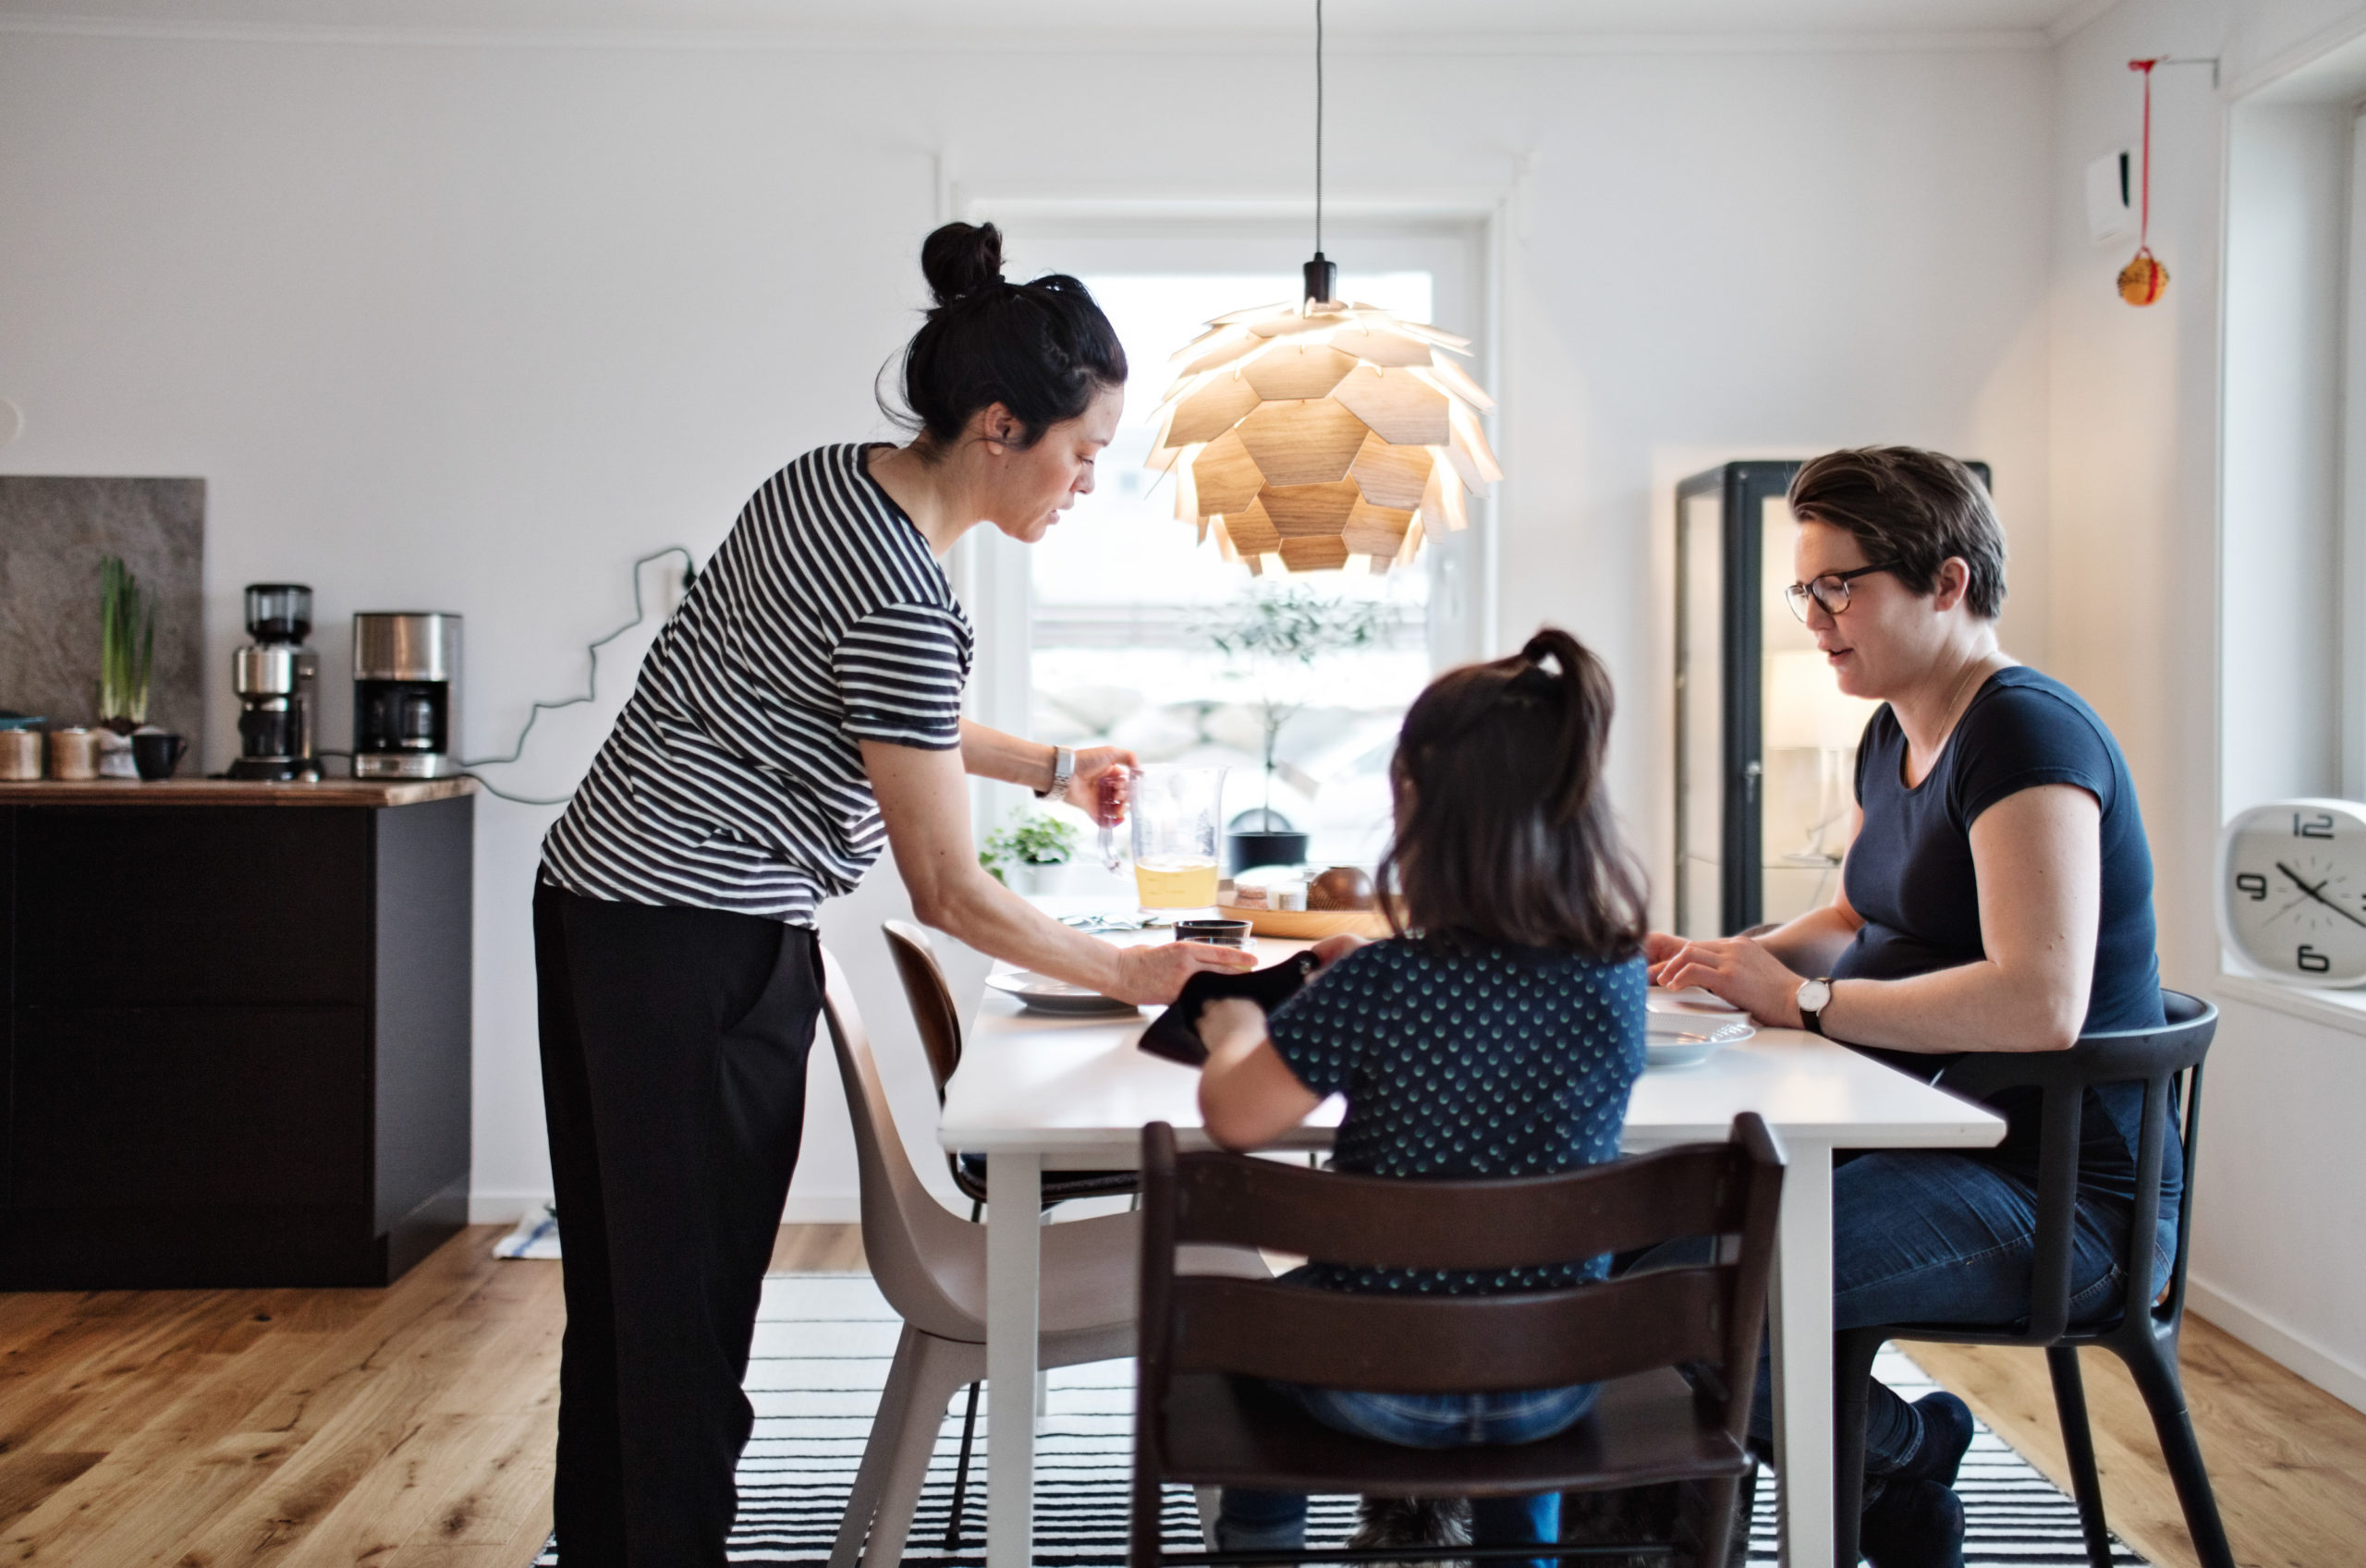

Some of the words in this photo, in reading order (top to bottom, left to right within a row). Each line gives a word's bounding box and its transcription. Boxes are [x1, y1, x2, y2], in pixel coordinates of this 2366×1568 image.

[2293, 812, 2336, 840] 12
[2236, 872, 2267, 901] 9
[2297, 943, 2330, 974] 6
